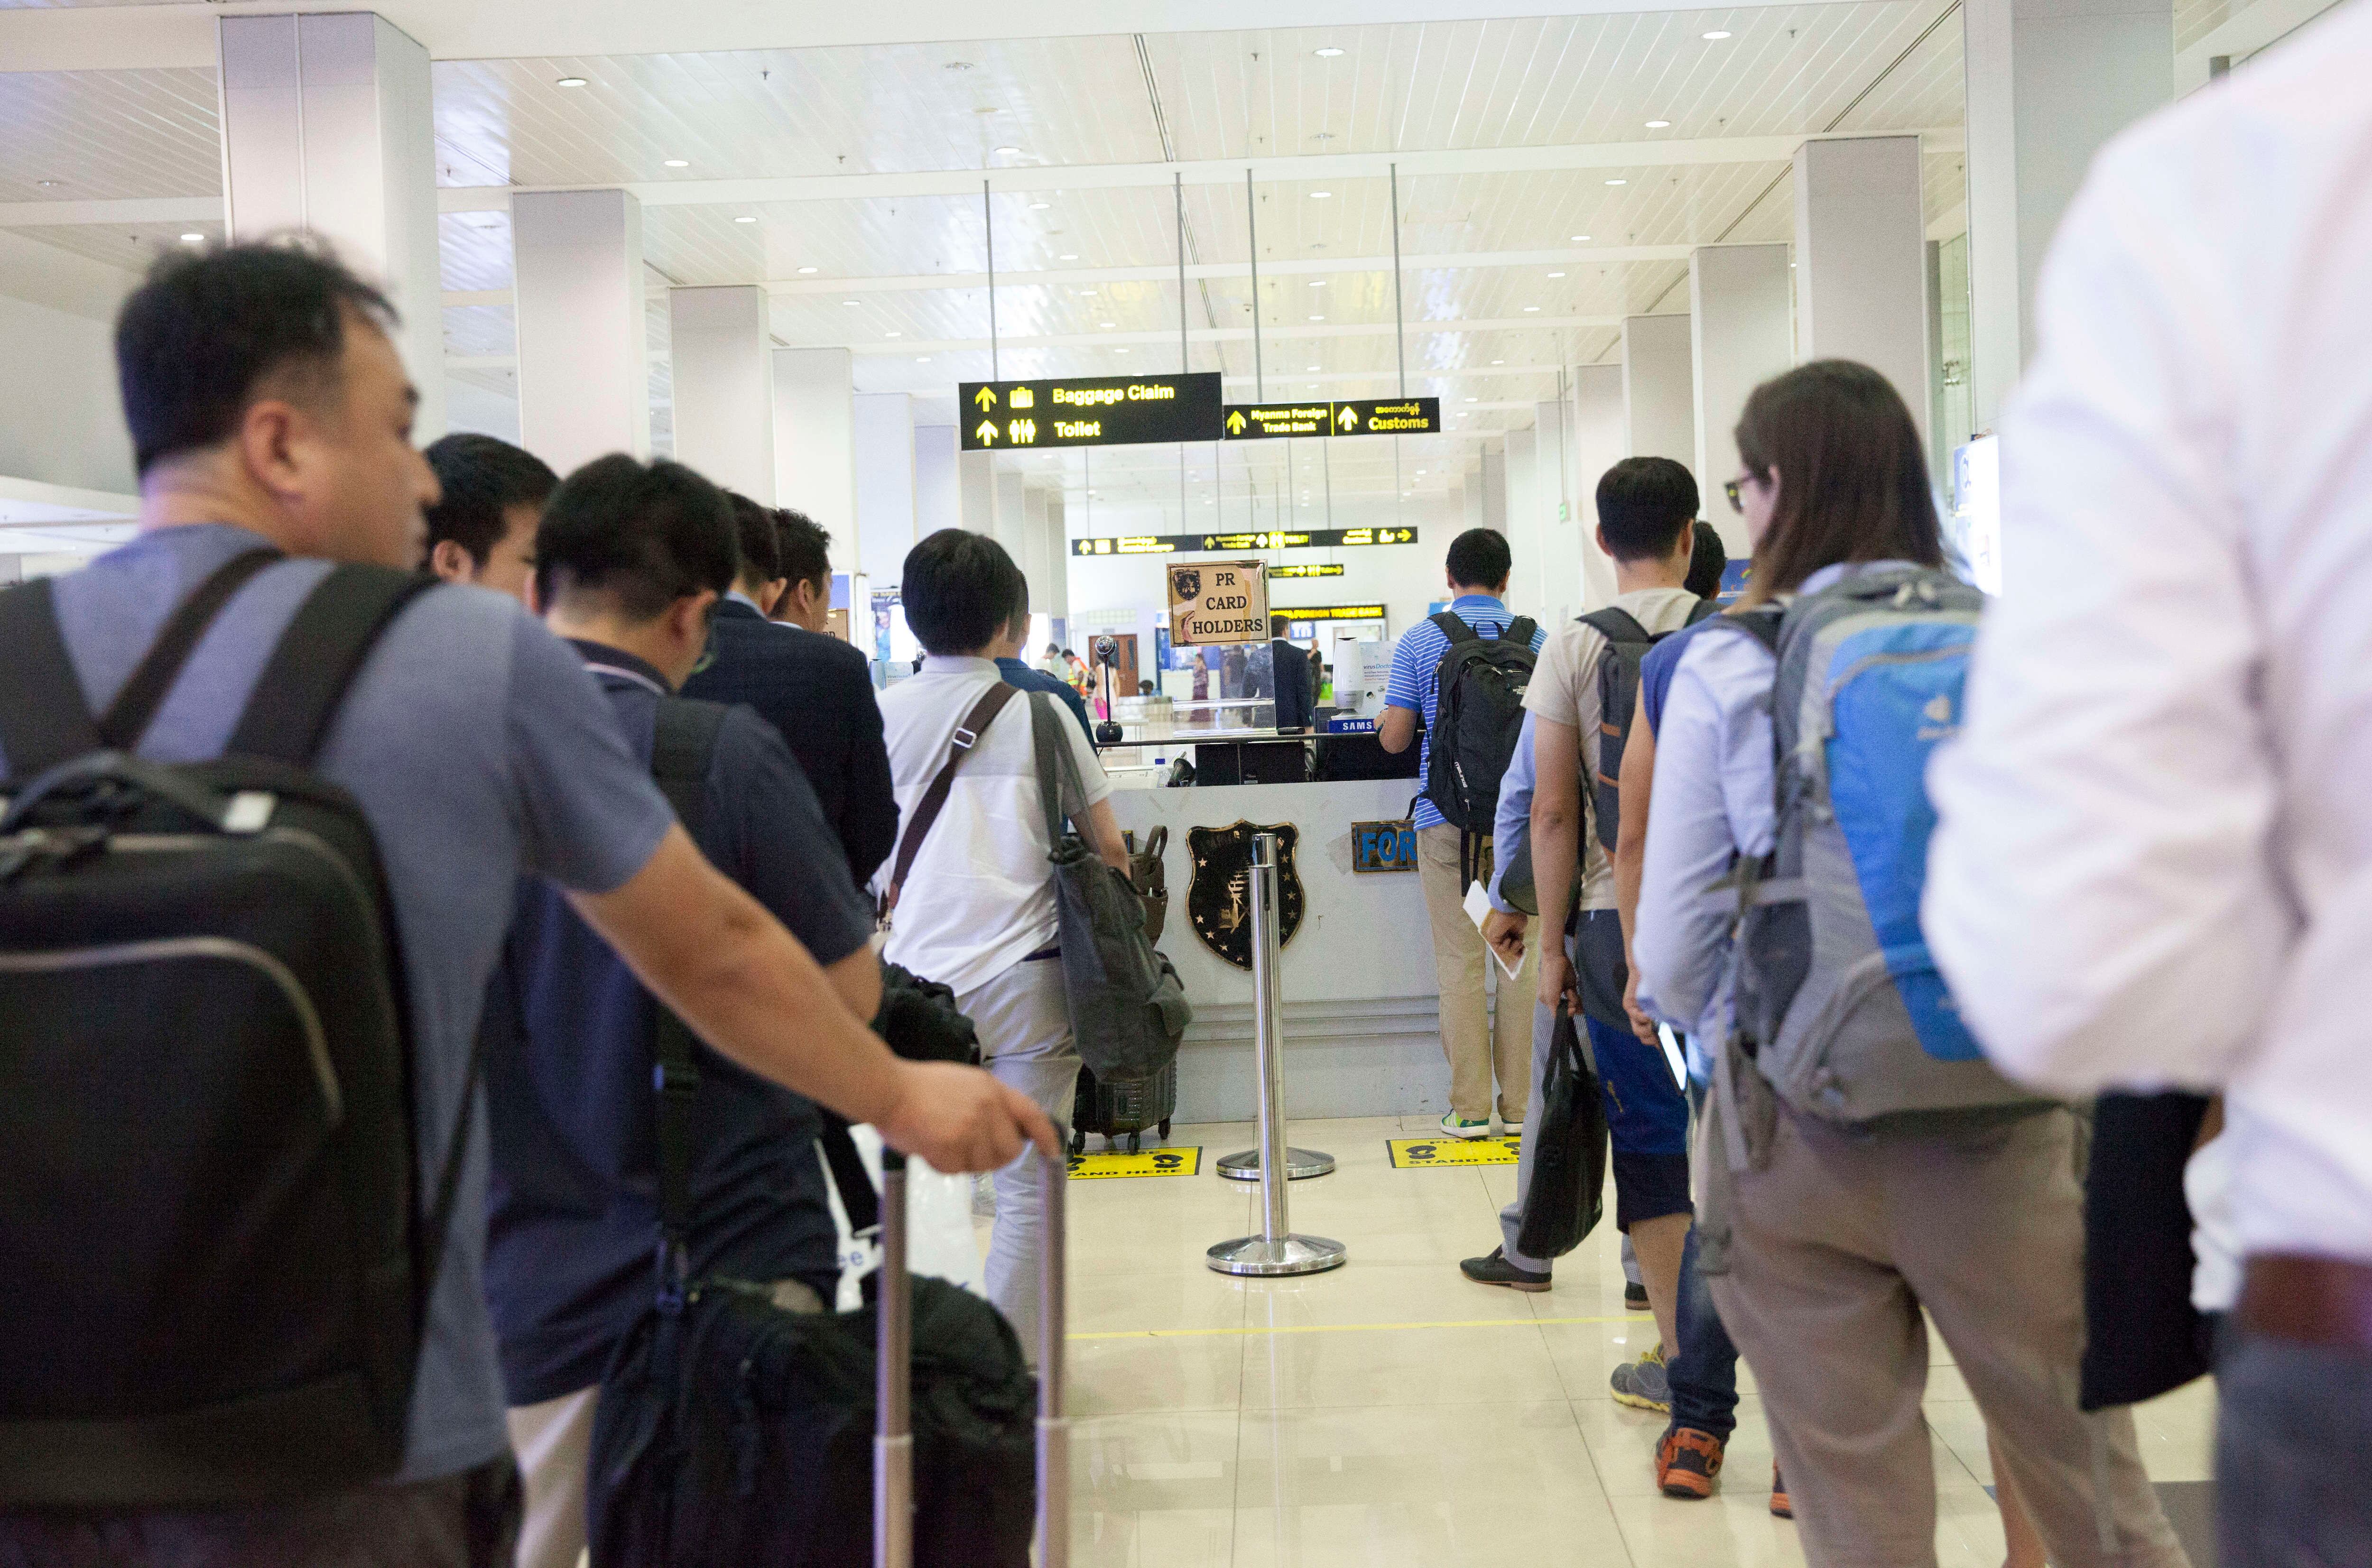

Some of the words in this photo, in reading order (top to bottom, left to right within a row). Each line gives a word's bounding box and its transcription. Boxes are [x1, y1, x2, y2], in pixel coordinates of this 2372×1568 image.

[1053, 388, 1124, 406] Baggage
[1128, 384, 1174, 400] Claim
[1251, 409, 1290, 422] Myanma
[1291, 407, 1327, 420] Foreign
[1054, 421, 1101, 437] Toilet
[1262, 422, 1291, 433] Trade
[1291, 421, 1316, 432] Bank
[1368, 417, 1429, 430] Customs
[1216, 573, 1235, 586] PR
[1206, 596, 1247, 610] CARD
[1193, 618, 1263, 635] HOLDERS
[1343, 721, 1372, 730] SAMS
[1362, 831, 1418, 863] FOR
